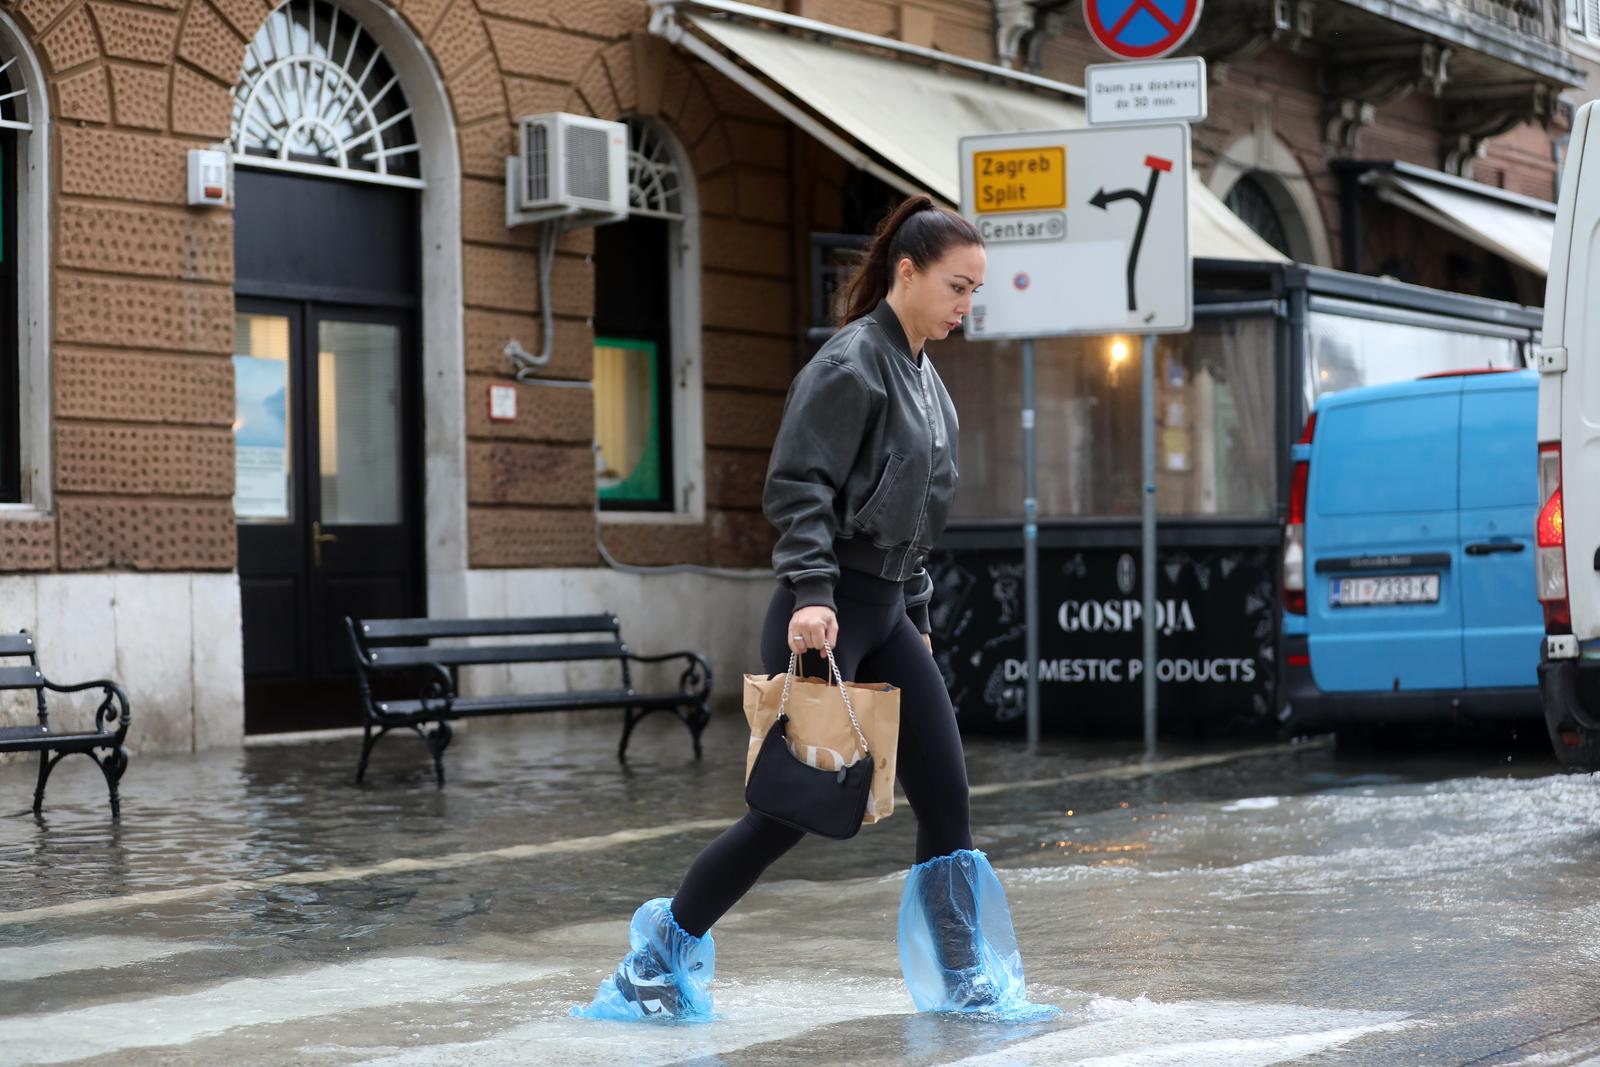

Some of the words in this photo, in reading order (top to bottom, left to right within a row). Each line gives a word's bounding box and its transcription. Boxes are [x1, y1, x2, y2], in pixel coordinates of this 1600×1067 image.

[1129, 83, 1143, 92] za
[1134, 96, 1149, 107] 30
[982, 154, 1051, 179] Zagreb
[983, 184, 1026, 206] Split
[980, 221, 1044, 239] Centar
[1128, 657, 1256, 682] PODUCTS
